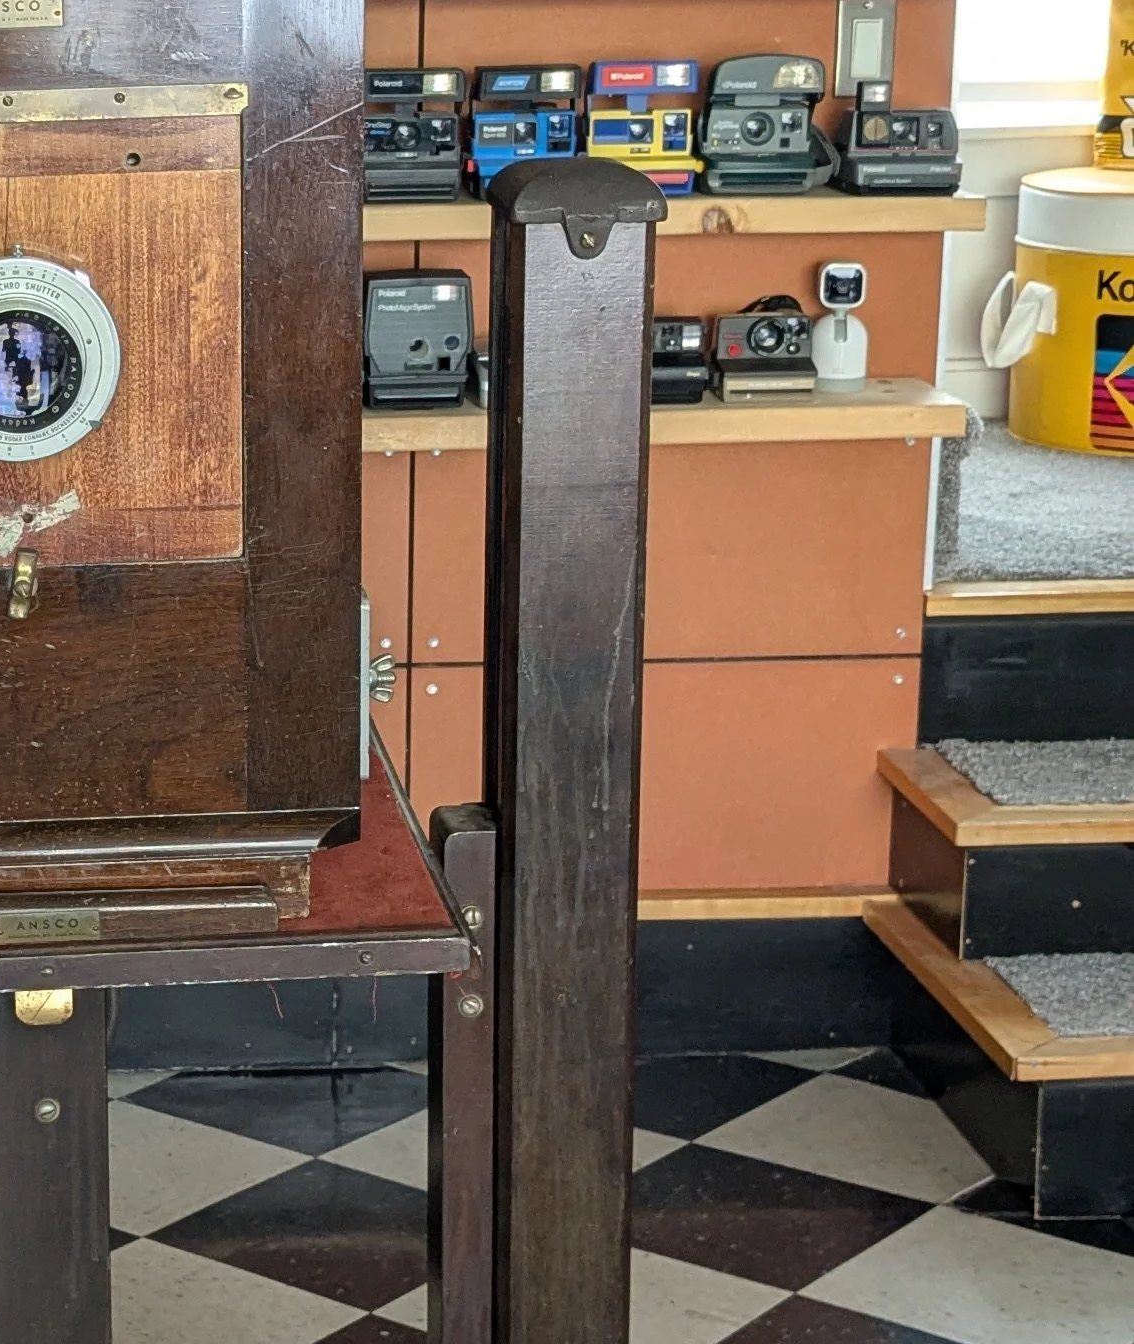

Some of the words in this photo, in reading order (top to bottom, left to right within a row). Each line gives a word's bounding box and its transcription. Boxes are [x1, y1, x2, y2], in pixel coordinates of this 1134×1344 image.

[617, 72, 644, 81] Polaroid
[374, 80, 403, 88] Polaroid
[726, 81, 757, 90] Polaroid
[25, 282, 61, 301] SHUTTER
[1, 418, 36, 427] Kodak
[17, 918, 78, 930] ANSCO
